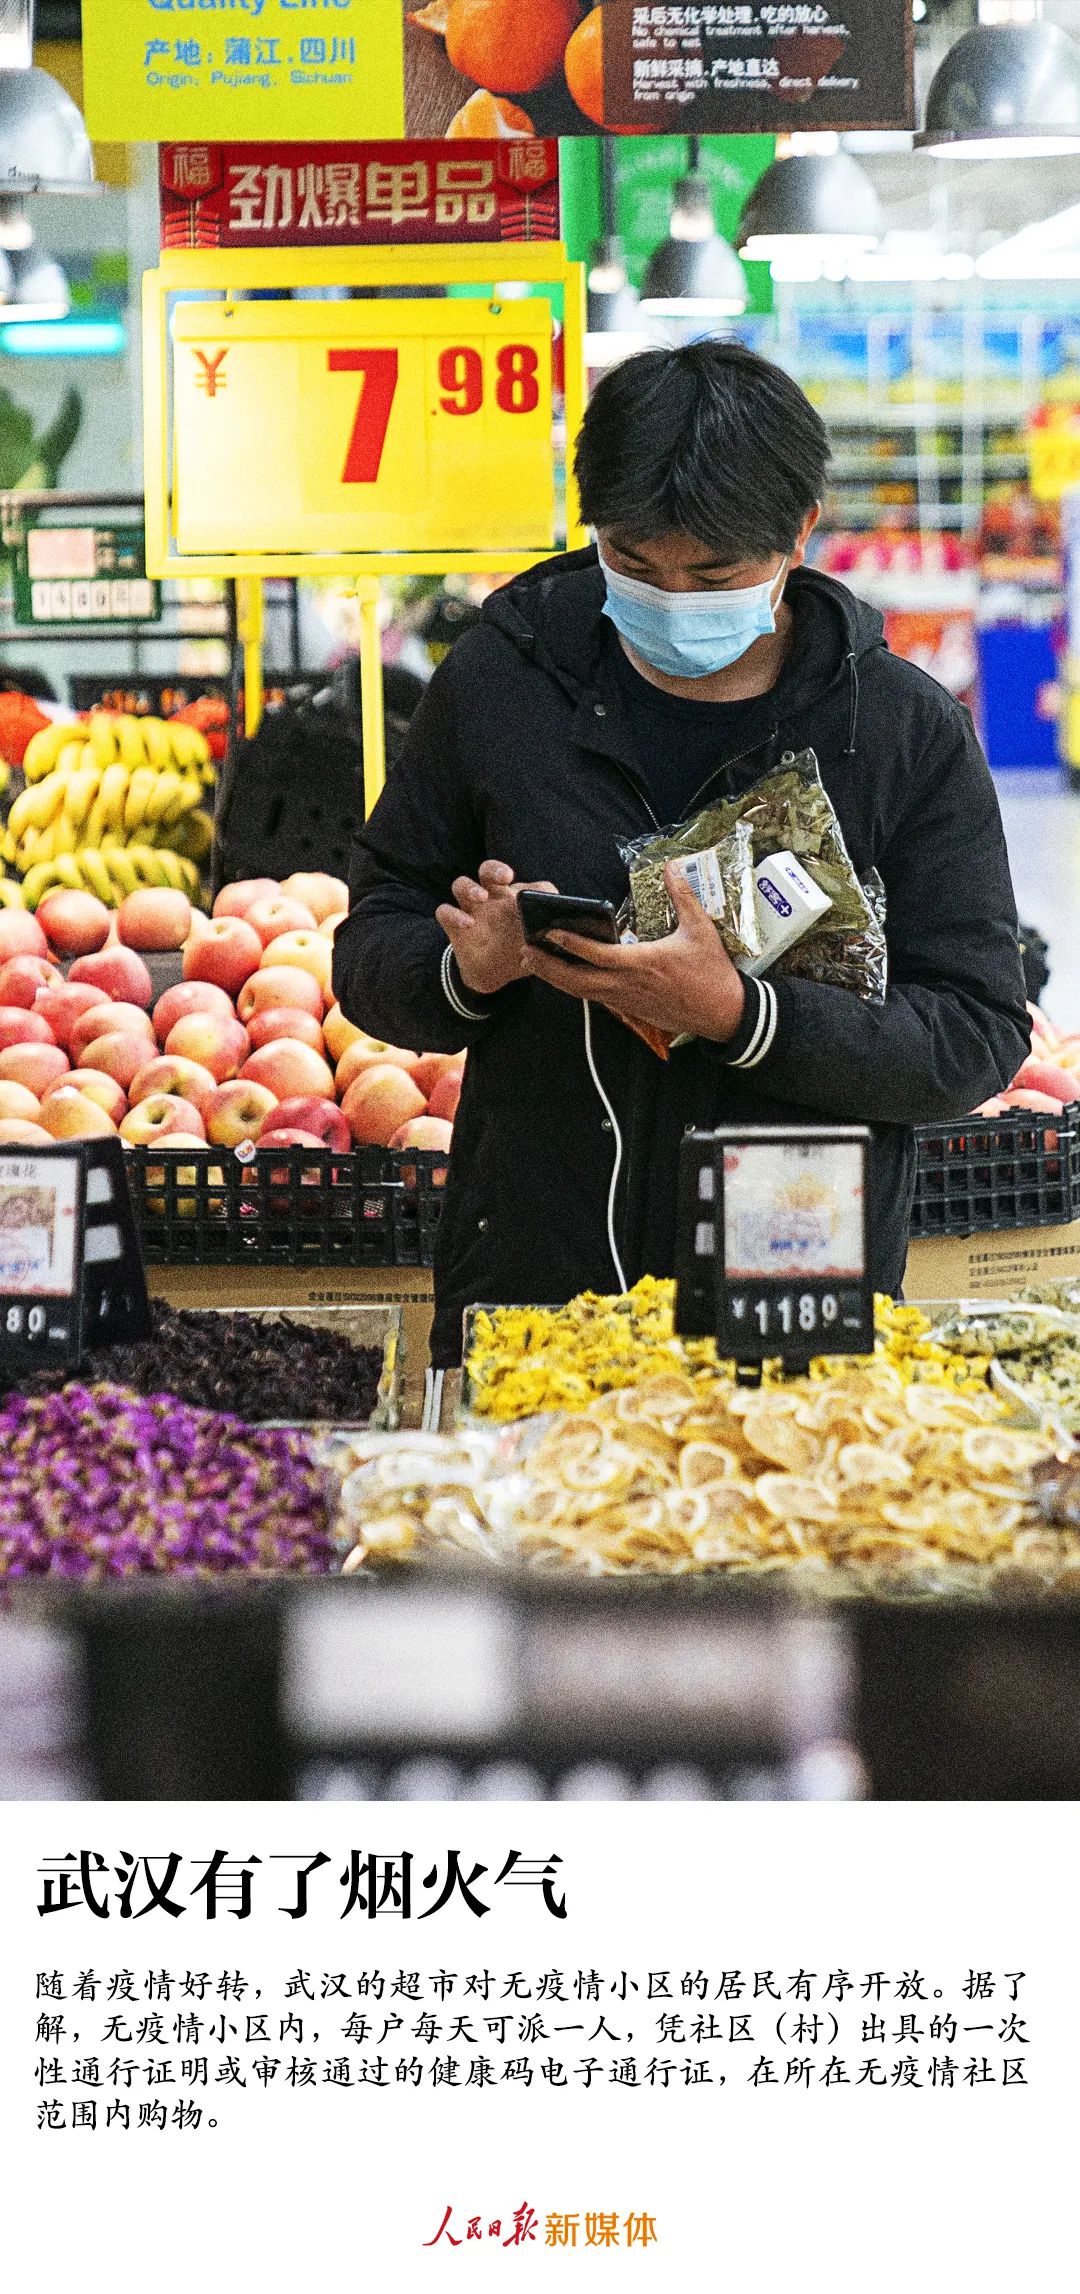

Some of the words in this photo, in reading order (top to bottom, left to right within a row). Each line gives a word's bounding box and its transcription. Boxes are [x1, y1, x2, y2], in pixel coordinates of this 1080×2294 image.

[767, 24, 798, 36] after
[632, 37, 657, 49] safe
[663, 38, 677, 49] to
[684, 77, 708, 89] with
[778, 77, 813, 88] direct
[633, 91, 661, 101] from
[664, 91, 696, 104] origin
[508, 139, 547, 181] 福
[172, 146, 211, 188] 福
[228, 159, 496, 230] 劲爆单品
